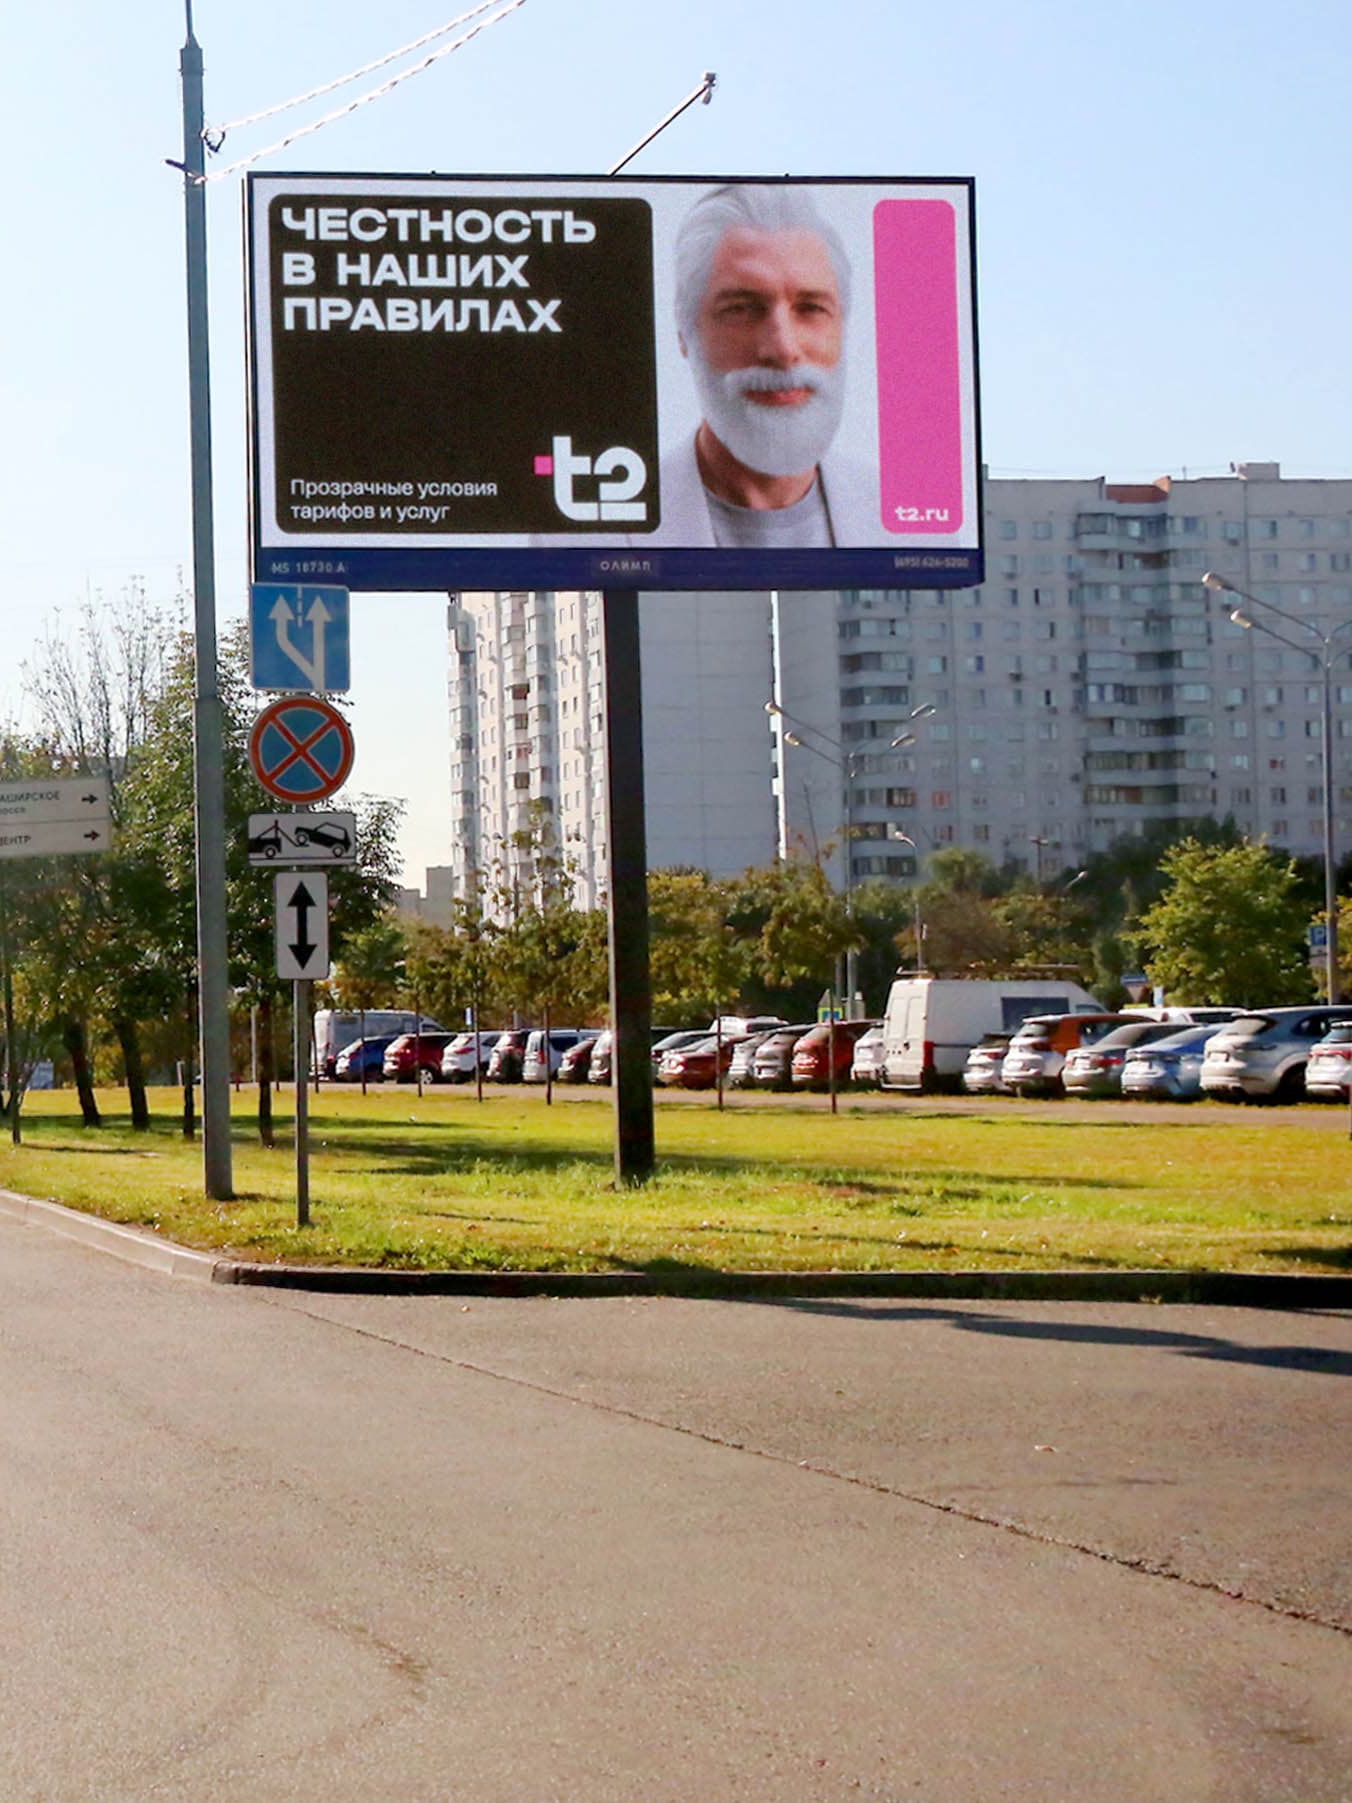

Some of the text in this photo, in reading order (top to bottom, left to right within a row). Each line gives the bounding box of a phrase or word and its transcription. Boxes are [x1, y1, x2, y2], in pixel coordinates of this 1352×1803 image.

[281, 207, 597, 244] ЧЕСТНОСТЬ
[282, 252, 530, 288] В НАШИХ
[283, 297, 563, 333] ПРАВИЛАХ
[290, 478, 498, 500] Прозрачные условия
[534, 435, 647, 521] t2
[290, 502, 451, 523] тарифов и услуг
[894, 505, 950, 522] t2.ru
